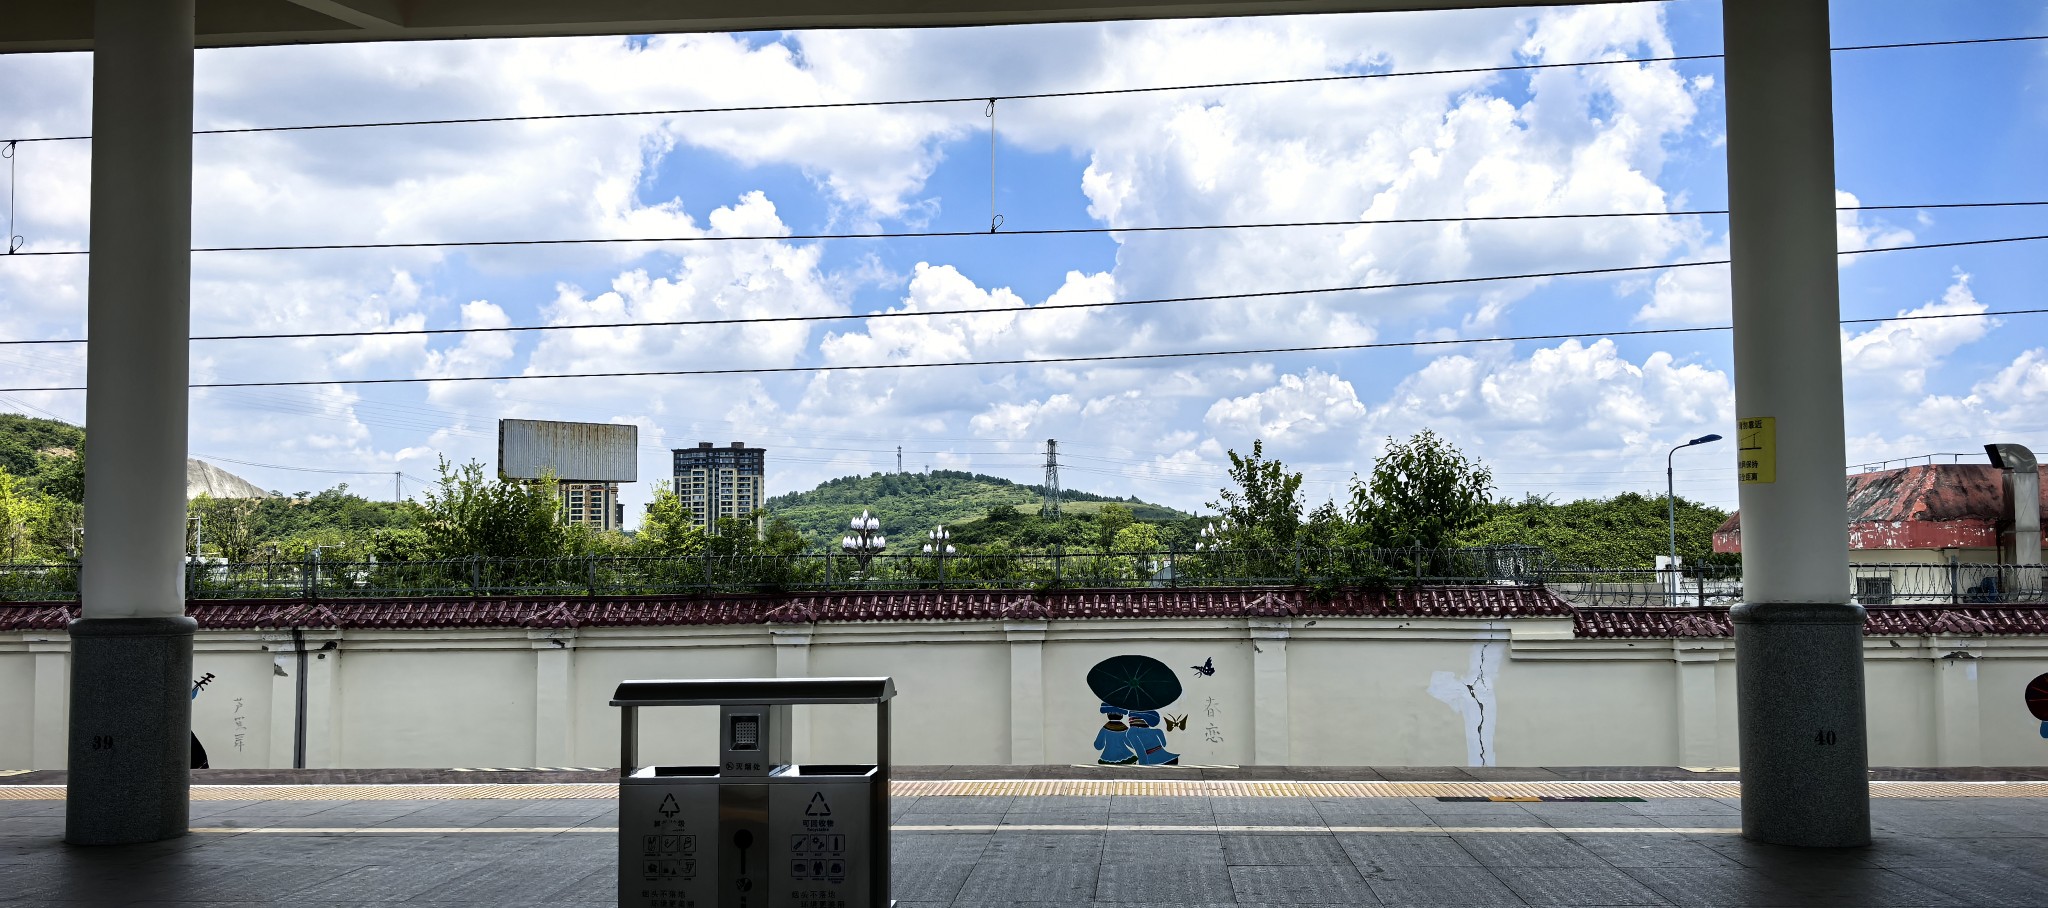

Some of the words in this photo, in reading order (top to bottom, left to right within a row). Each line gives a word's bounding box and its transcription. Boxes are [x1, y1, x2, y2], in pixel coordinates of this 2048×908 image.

[93, 735, 113, 750] 39
[1814, 730, 1837, 745] 40
[802, 819, 834, 827] 可回收物
